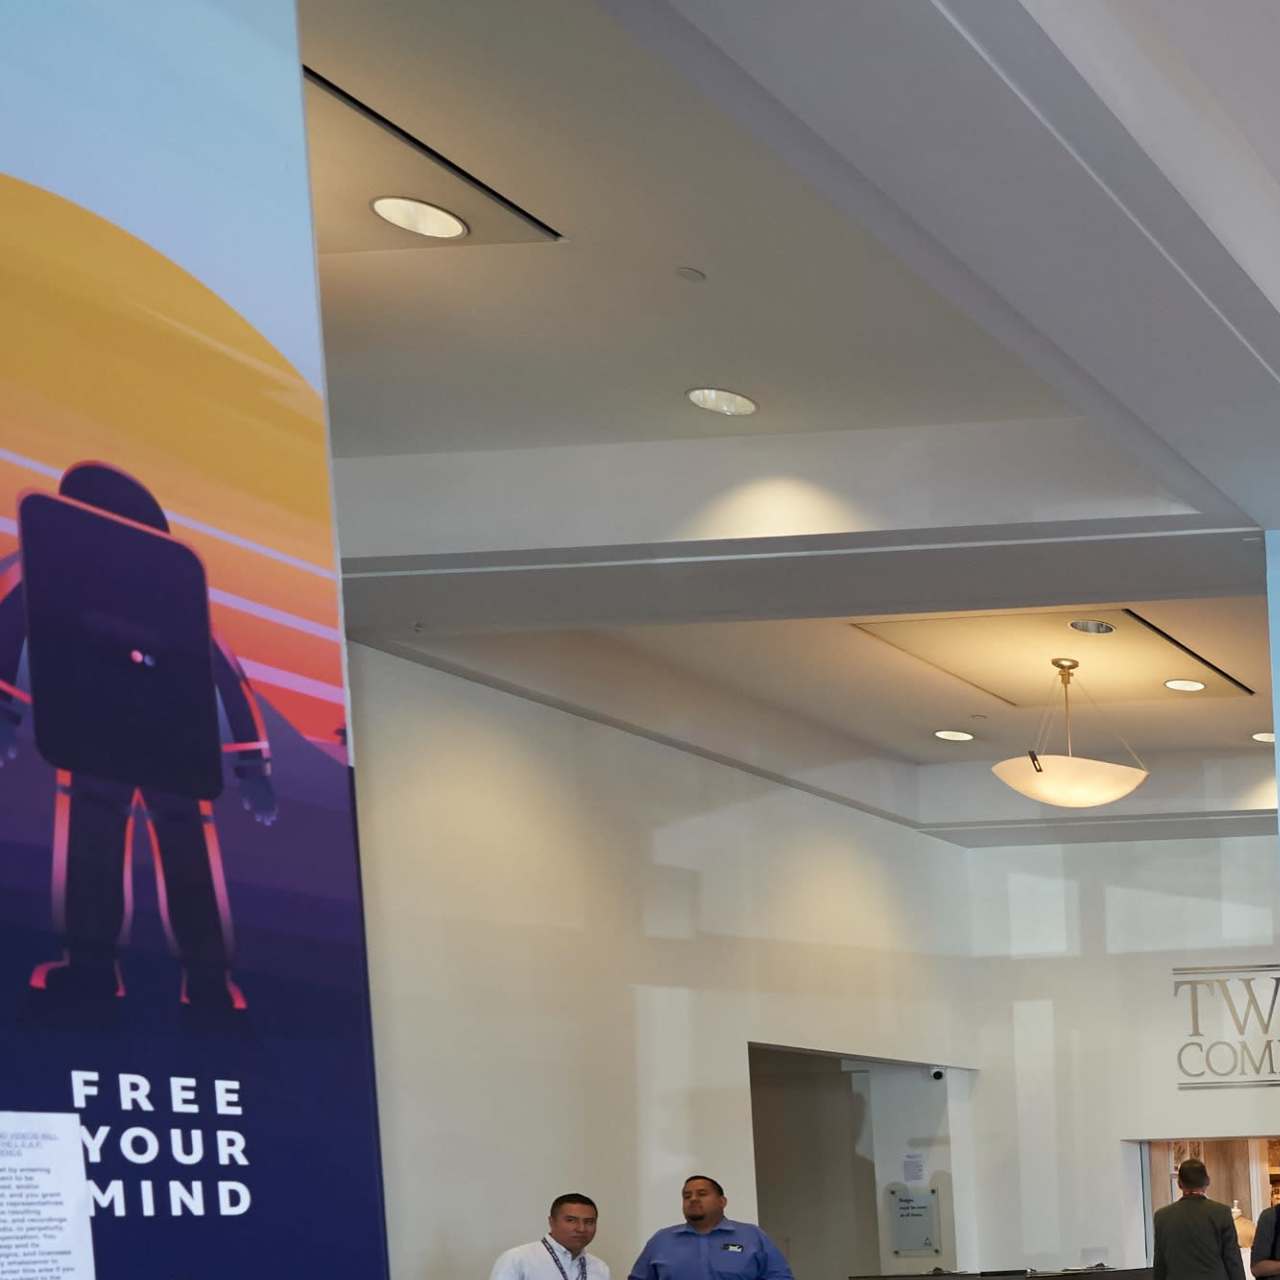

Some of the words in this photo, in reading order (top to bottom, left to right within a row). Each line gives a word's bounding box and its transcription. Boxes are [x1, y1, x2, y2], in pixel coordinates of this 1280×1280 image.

[71, 1070, 243, 1115] FREE
[80, 1126, 249, 1166] YOUR
[86, 1180, 251, 1217] MIND
